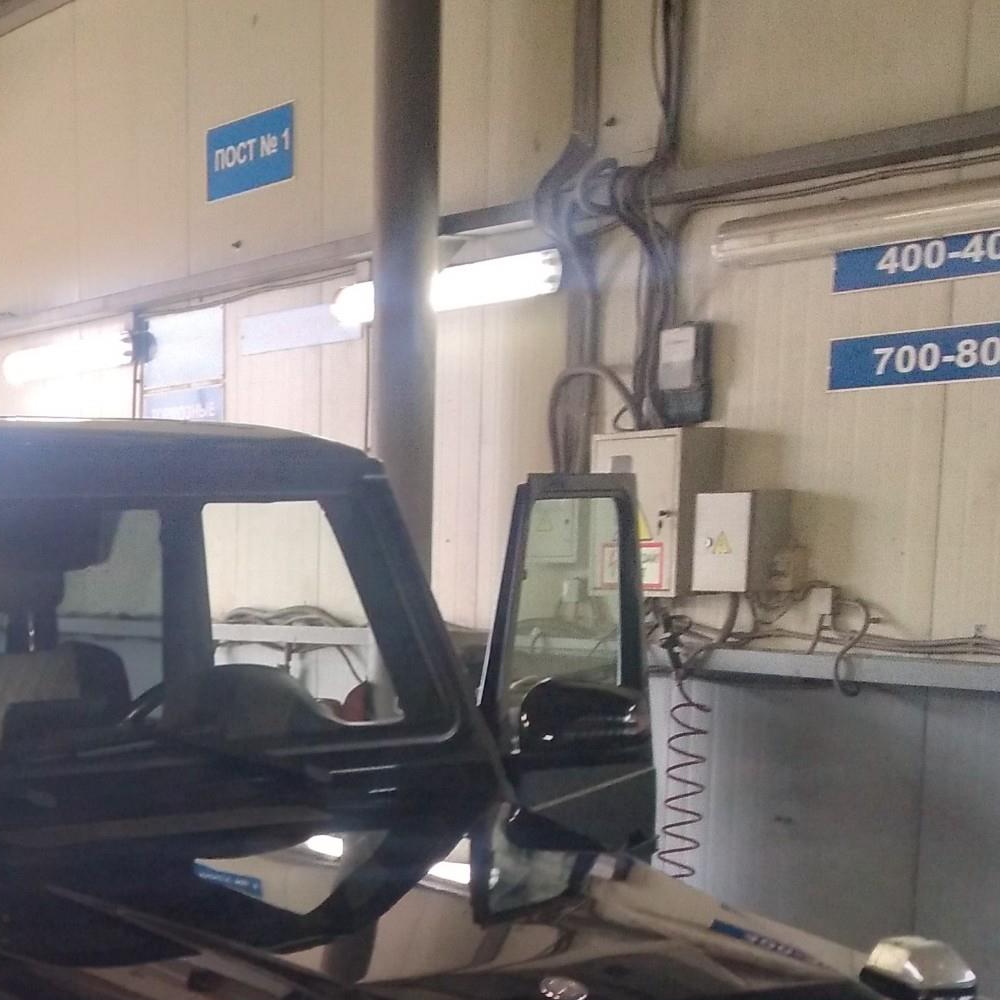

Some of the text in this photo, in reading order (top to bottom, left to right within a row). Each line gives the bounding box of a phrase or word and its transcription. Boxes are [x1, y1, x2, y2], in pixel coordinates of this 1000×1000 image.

[214, 138, 257, 172] ПОСТ
[282, 127, 290, 151] 1
[873, 336, 1000, 376] 700-80
